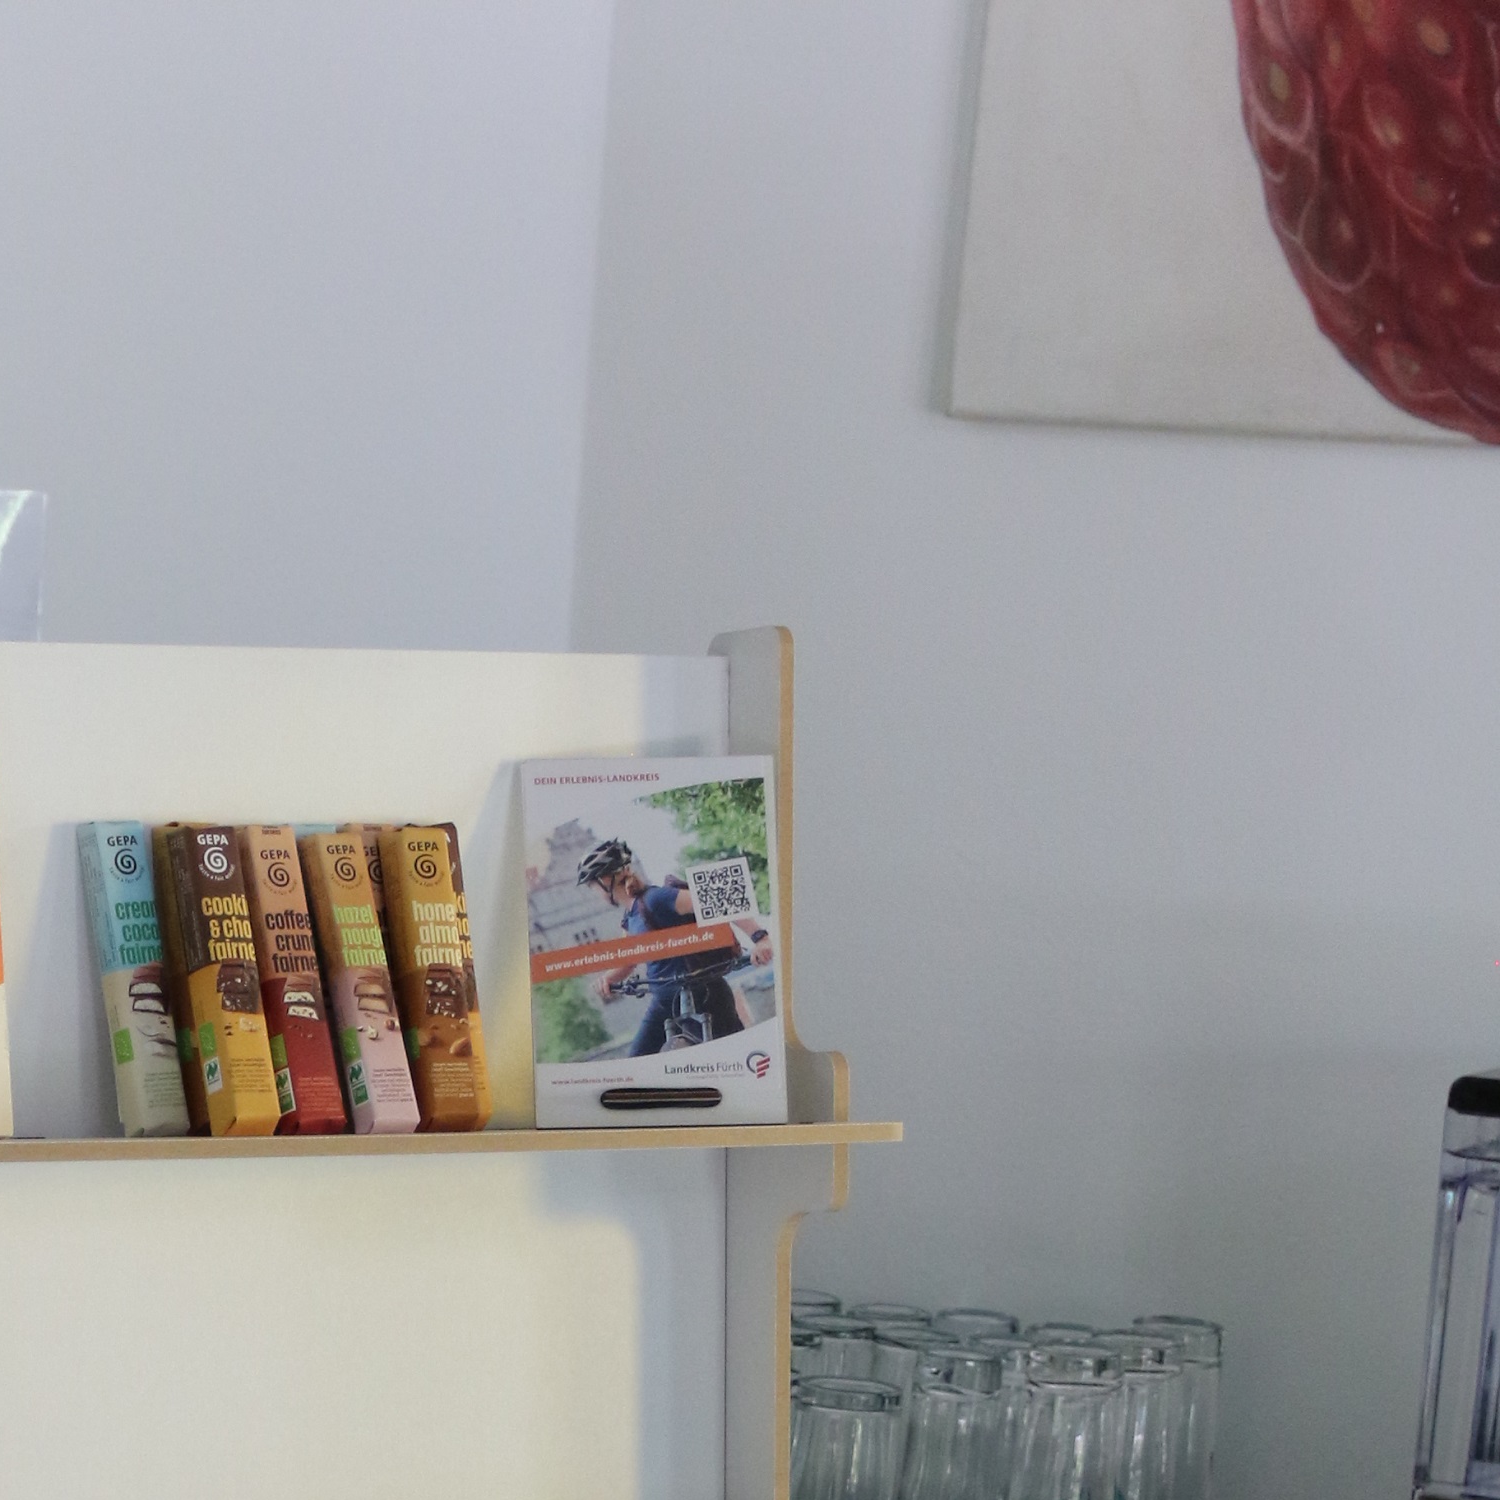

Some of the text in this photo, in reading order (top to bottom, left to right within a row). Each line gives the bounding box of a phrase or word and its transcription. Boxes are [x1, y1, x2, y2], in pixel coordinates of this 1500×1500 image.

[107, 835, 139, 847] GEPA
[196, 833, 229, 846] GEPA
[326, 844, 357, 855] GEPA
[407, 841, 440, 852] GEPA
[260, 849, 291, 861] GEPA
[544, 930, 715, 973] www.erlebnis-landkreis-fuerth.de
[664, 1060, 744, 1075] Landkreis Fürth
